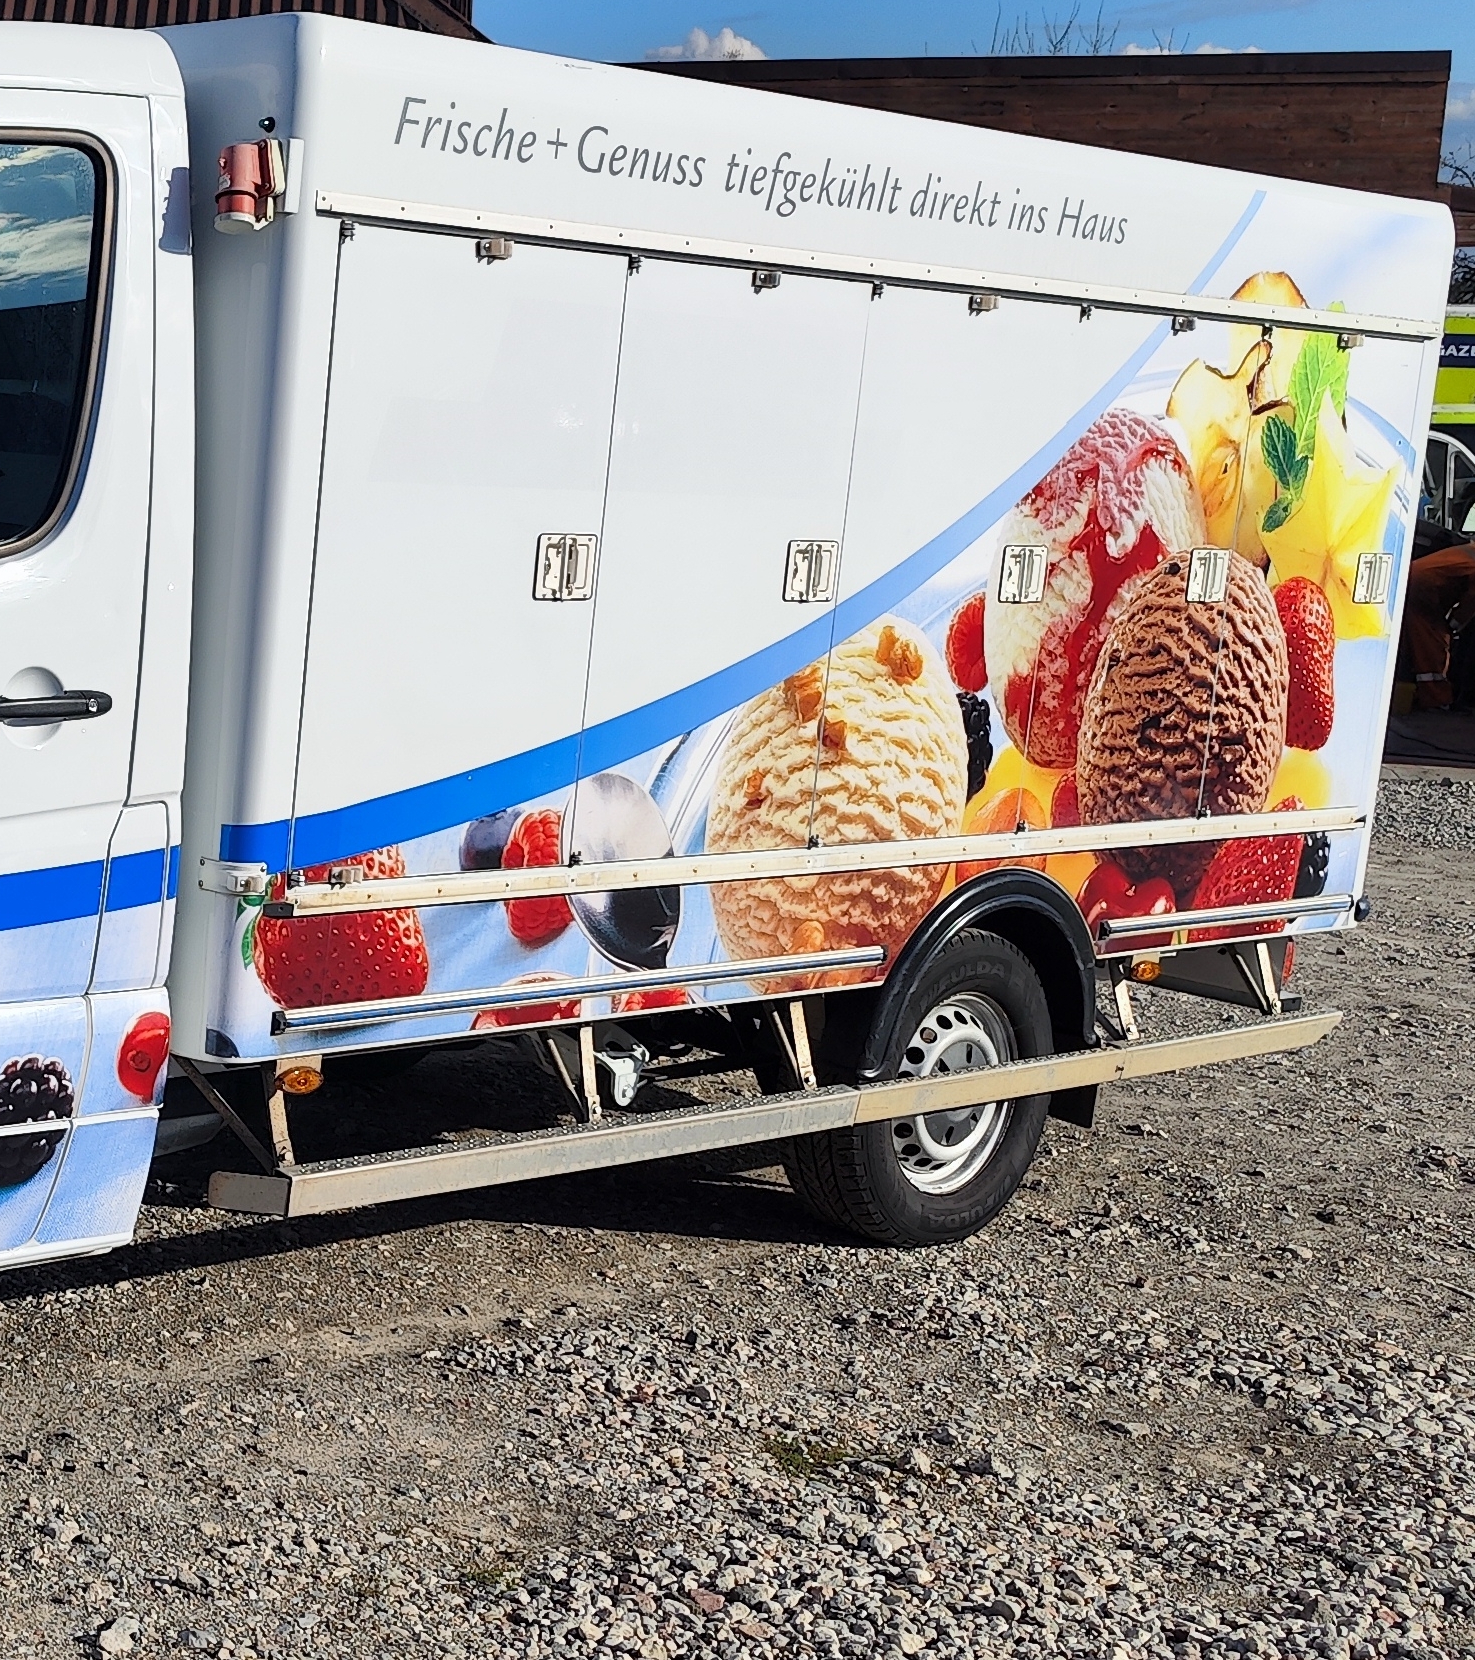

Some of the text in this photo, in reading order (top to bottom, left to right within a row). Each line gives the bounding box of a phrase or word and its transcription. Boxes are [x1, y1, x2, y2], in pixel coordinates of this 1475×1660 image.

[724, 148, 903, 218] tiefgekühlt
[909, 172, 1002, 229] direkt
[1007, 187, 1049, 234] ins
[1056, 196, 1129, 245] Haus
